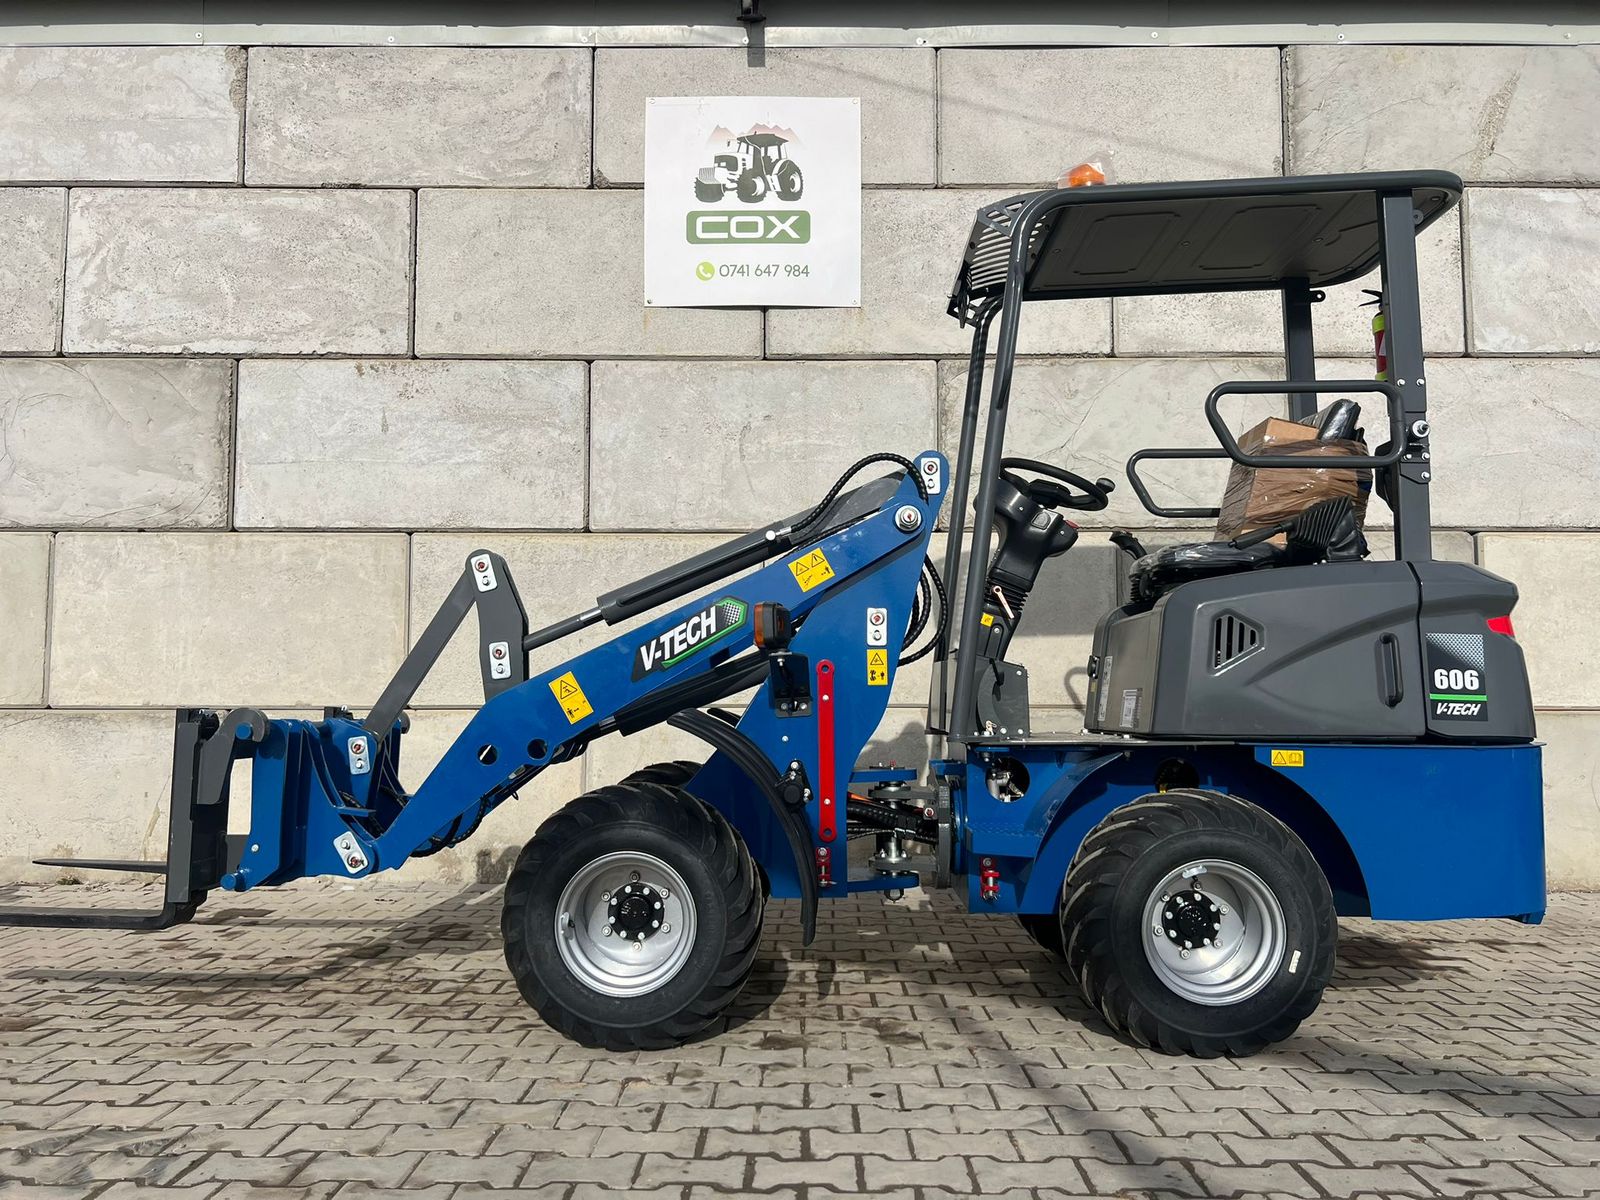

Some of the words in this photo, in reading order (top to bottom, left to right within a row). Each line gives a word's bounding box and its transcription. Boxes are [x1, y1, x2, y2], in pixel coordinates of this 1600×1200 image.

[696, 215, 800, 238] COX
[719, 264, 750, 277] 0741
[754, 264, 780, 277] 647
[784, 264, 810, 277] 984
[640, 605, 717, 671] V-TECH
[1434, 668, 1480, 691] 606
[1436, 702, 1482, 716] V-TECH
